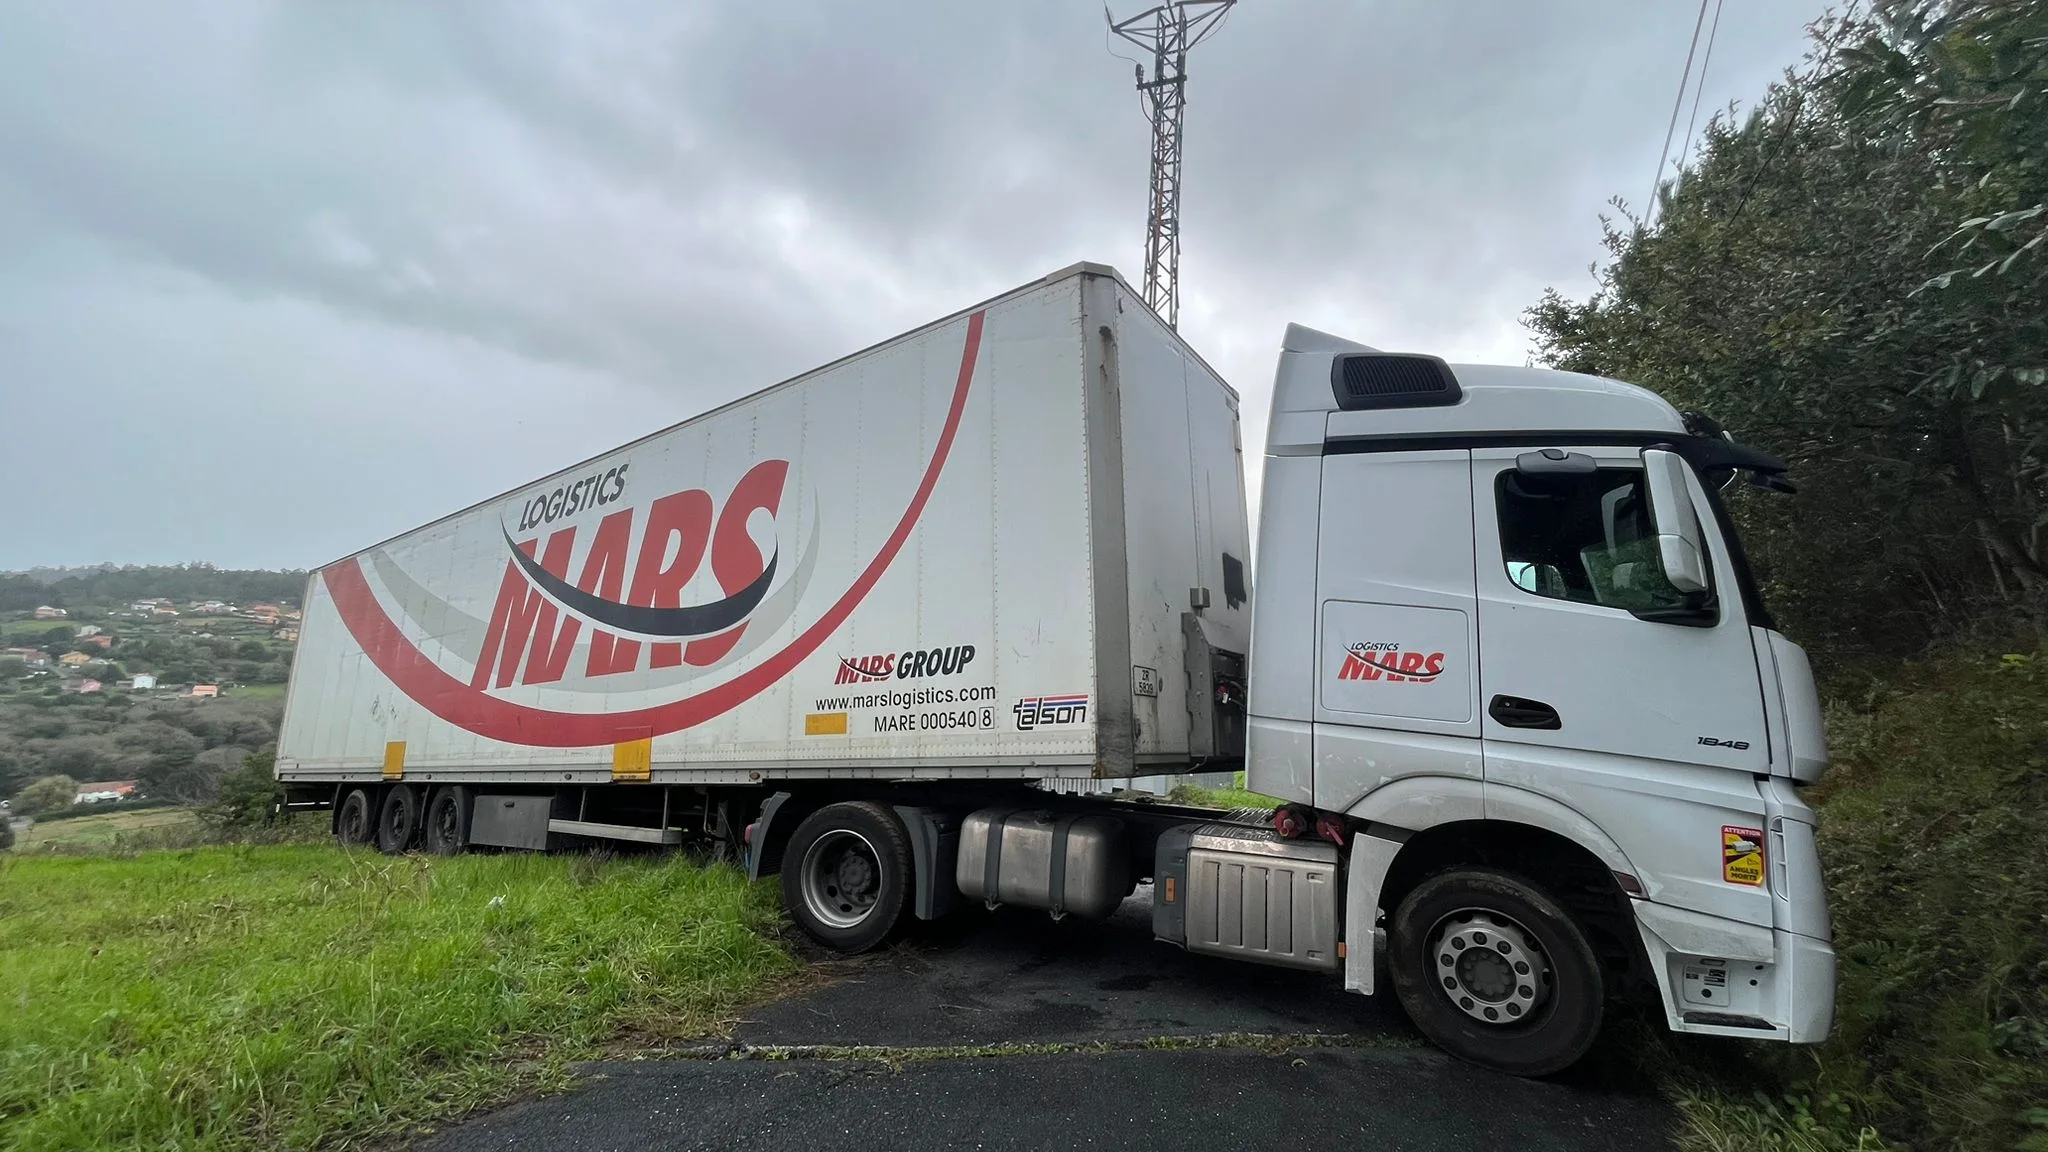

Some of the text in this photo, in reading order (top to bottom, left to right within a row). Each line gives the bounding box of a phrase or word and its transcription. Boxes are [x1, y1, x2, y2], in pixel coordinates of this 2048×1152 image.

[518, 463, 630, 532] LOGISTICS
[470, 459, 790, 692] MARS
[1350, 641, 1400, 651] LOGISTICS
[834, 645, 976, 685] MARS GROUP
[1337, 651, 1445, 683] MARS
[815, 685, 996, 711] www.marslogistics.com
[874, 709, 992, 732] MARE 000540 8
[1013, 698, 1088, 731] talson
[1697, 736, 1750, 750] 1848
[1723, 827, 1761, 837] ATTENTION
[1729, 866, 1759, 875] ANGLES
[1730, 873, 1758, 881] MORTS
